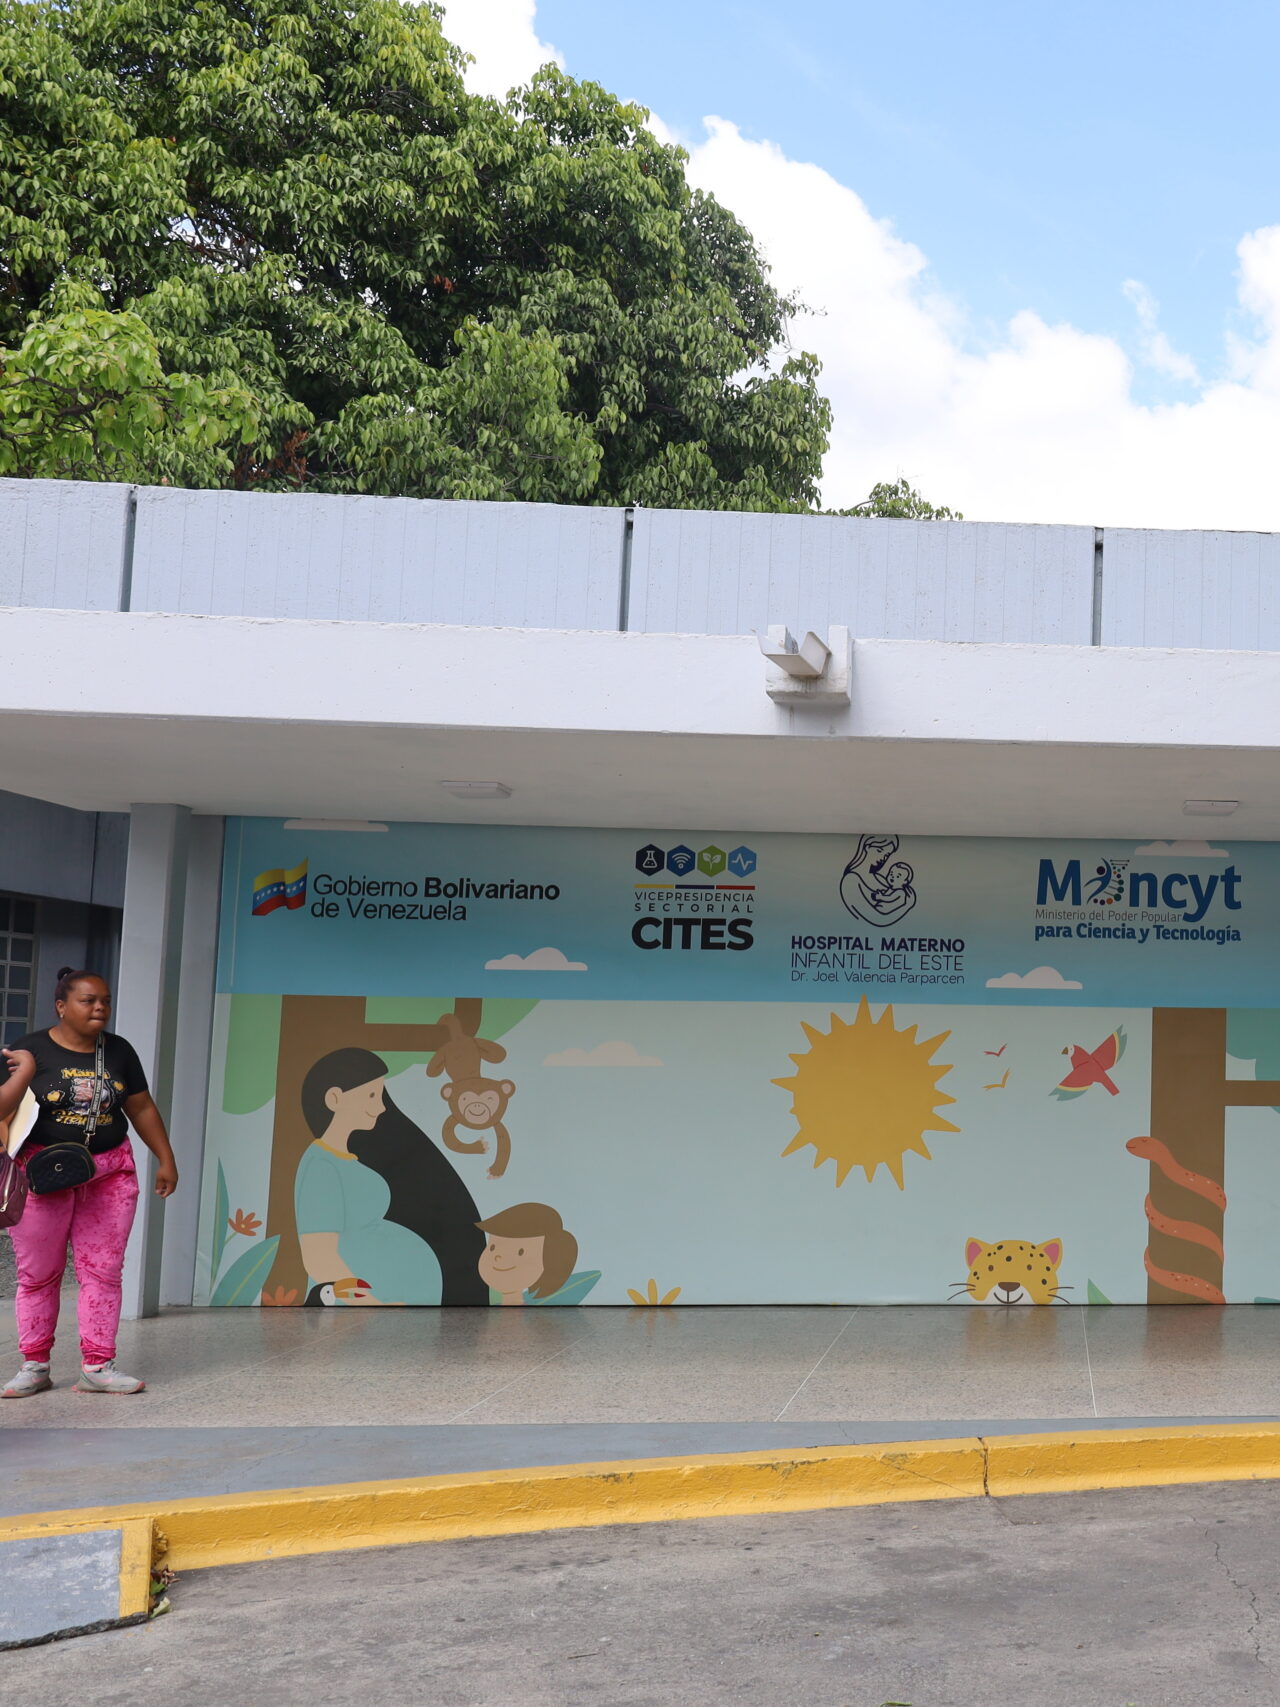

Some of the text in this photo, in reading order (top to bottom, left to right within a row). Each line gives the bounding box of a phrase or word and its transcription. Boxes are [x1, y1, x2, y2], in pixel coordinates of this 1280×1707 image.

[313, 874, 560, 901] Gobierno Bolivariano
[634, 891, 755, 902] VICEPRESIDENCIA
[311, 897, 467, 921] de Venezuela
[634, 903, 753, 913] SECTORIAL
[1035, 908, 1182, 924] Ministerio del Poder Popular
[631, 916, 754, 951] CITES
[1035, 922, 1242, 945] para Ciencia y Tecnología
[791, 935, 965, 953] HOSPITAL MATERNO
[791, 952, 964, 971] INFANTIL DEL ESTE
[791, 970, 965, 986] Dr. Joel Valencia Parparcen
